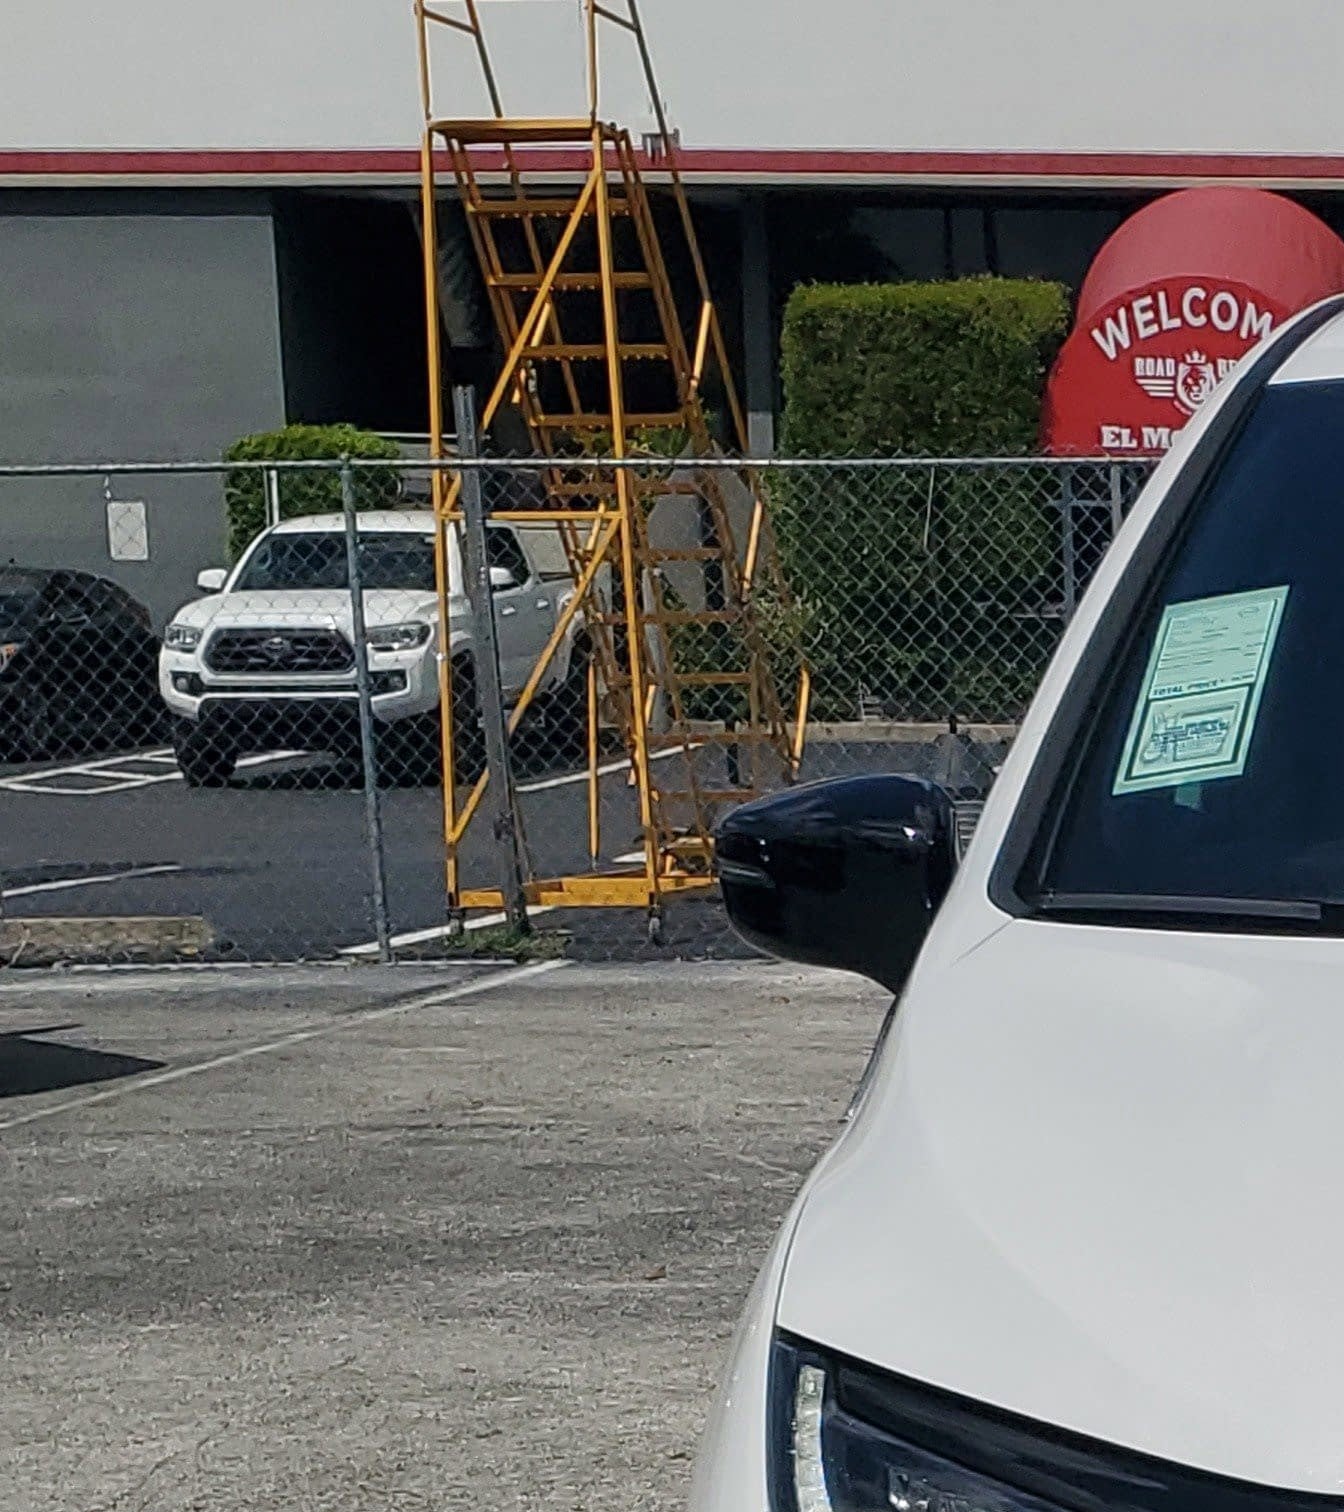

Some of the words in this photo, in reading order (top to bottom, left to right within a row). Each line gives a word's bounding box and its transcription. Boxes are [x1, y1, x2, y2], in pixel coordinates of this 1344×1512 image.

[1091, 287, 1273, 361] WELCOM
[1133, 357, 1176, 377] ROAD
[1101, 425, 1138, 448] EL
